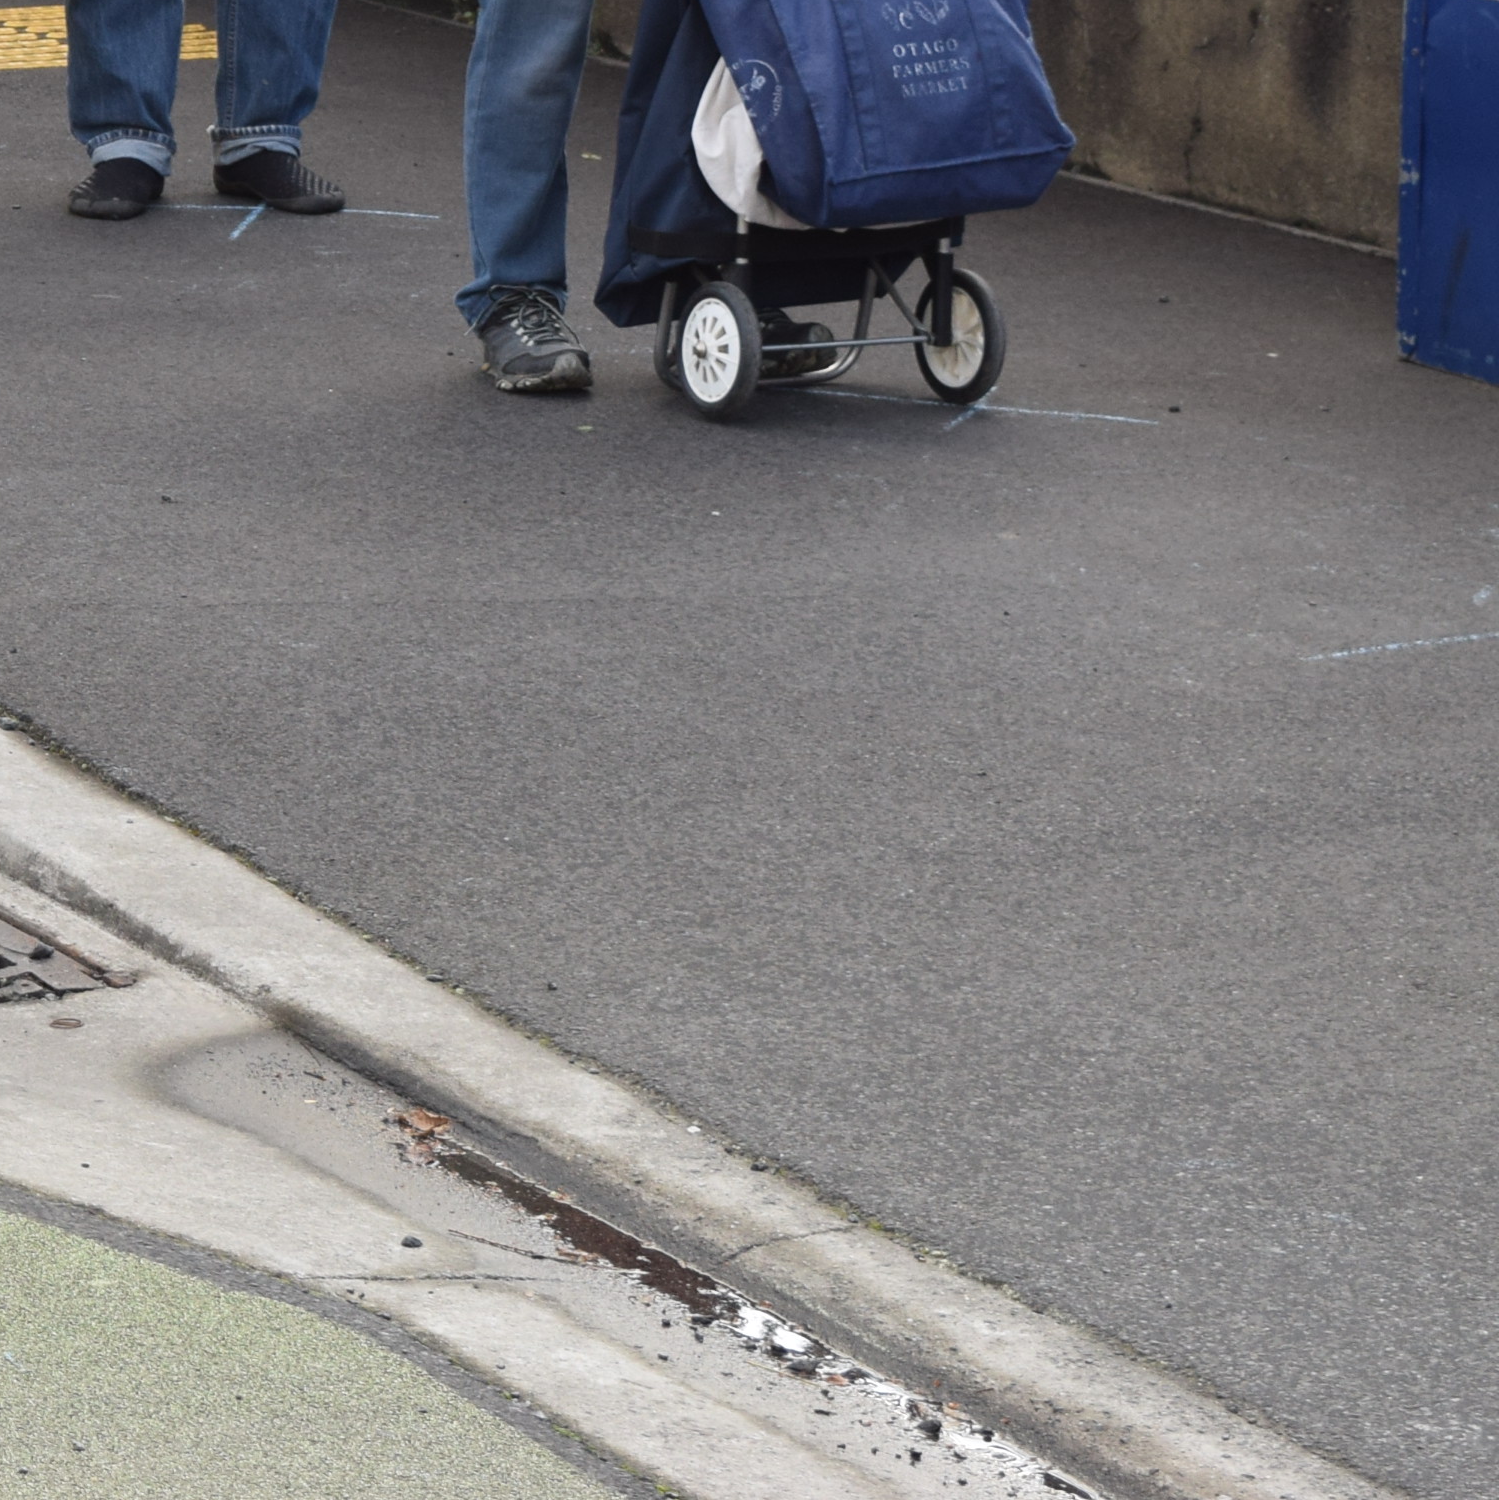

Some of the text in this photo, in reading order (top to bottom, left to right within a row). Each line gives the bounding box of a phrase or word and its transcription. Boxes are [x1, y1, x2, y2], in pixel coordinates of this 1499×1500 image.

[892, 37, 959, 58] OTAGO
[892, 57, 971, 78] FARMERS
[901, 76, 968, 98] MARKET
